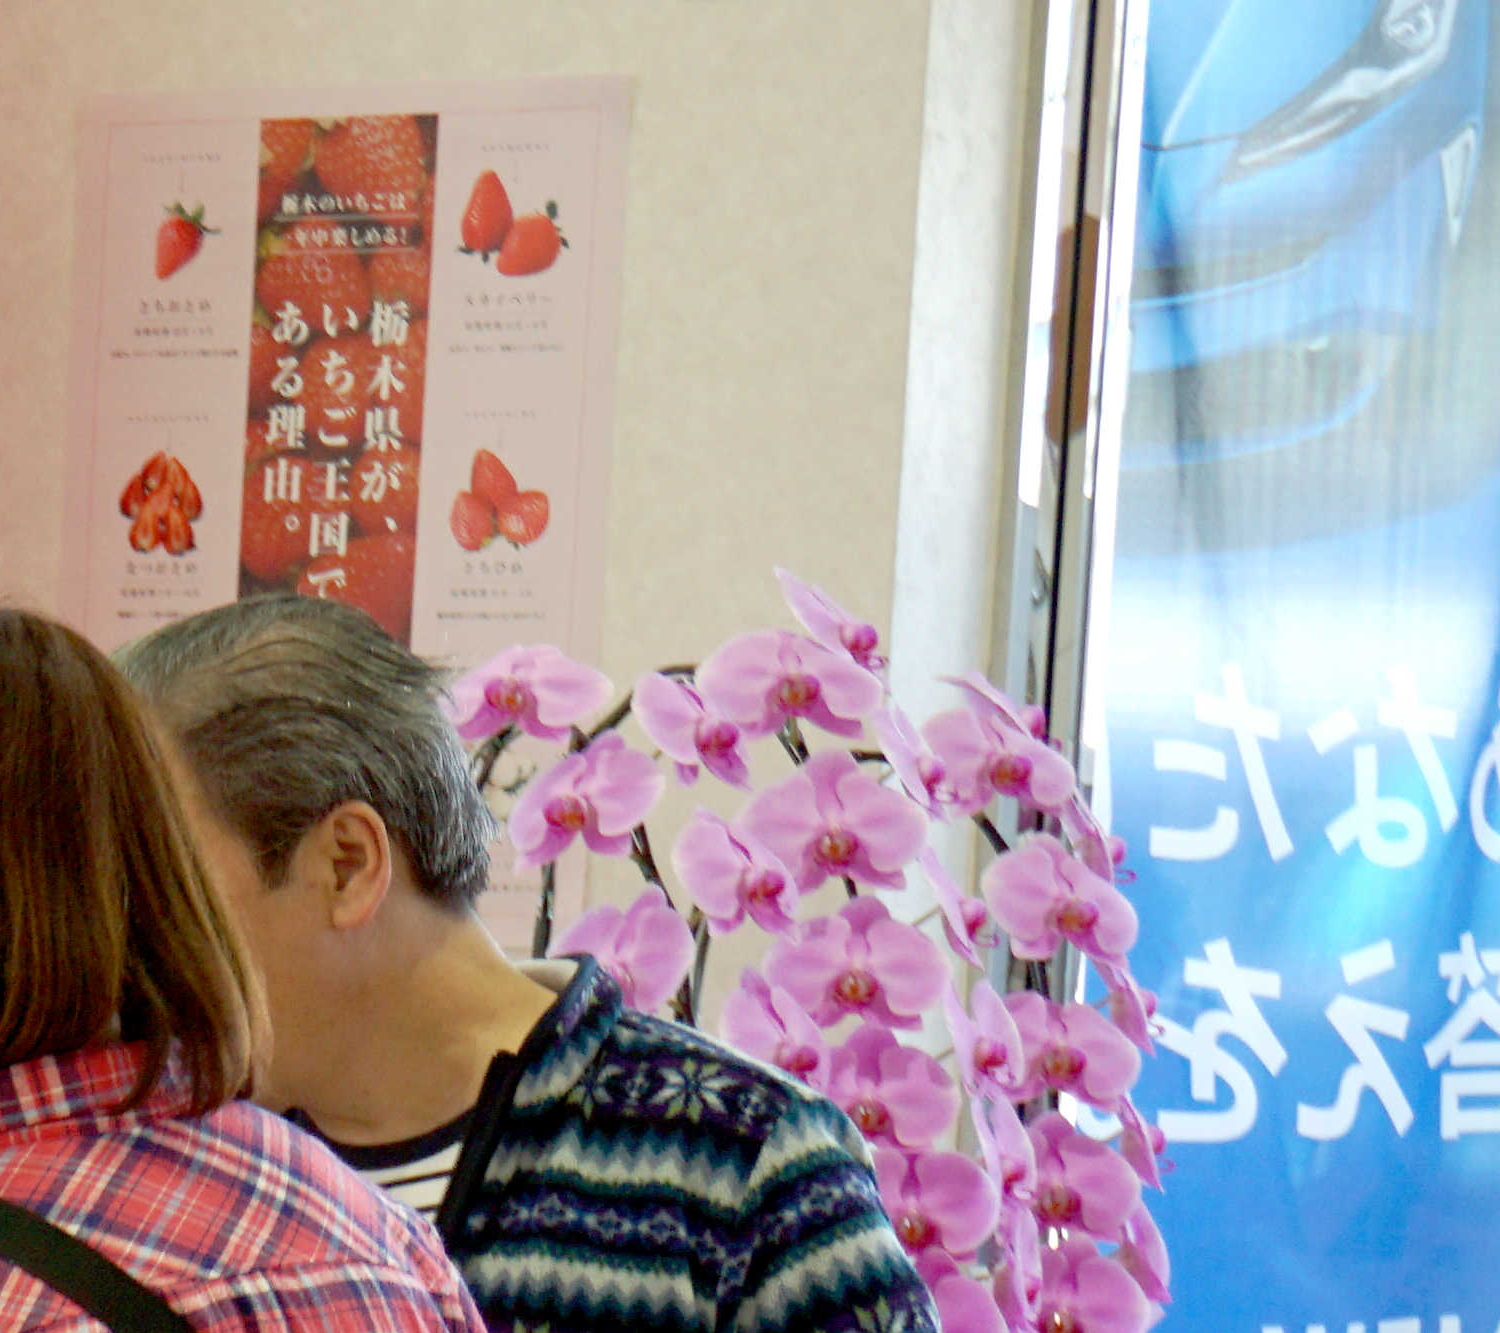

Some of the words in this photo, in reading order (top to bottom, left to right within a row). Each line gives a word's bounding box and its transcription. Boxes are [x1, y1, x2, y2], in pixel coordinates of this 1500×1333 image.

[262, 302, 310, 534] ある理由。
[307, 303, 360, 600] いちご王国で
[359, 300, 411, 533] 栃木県が、
